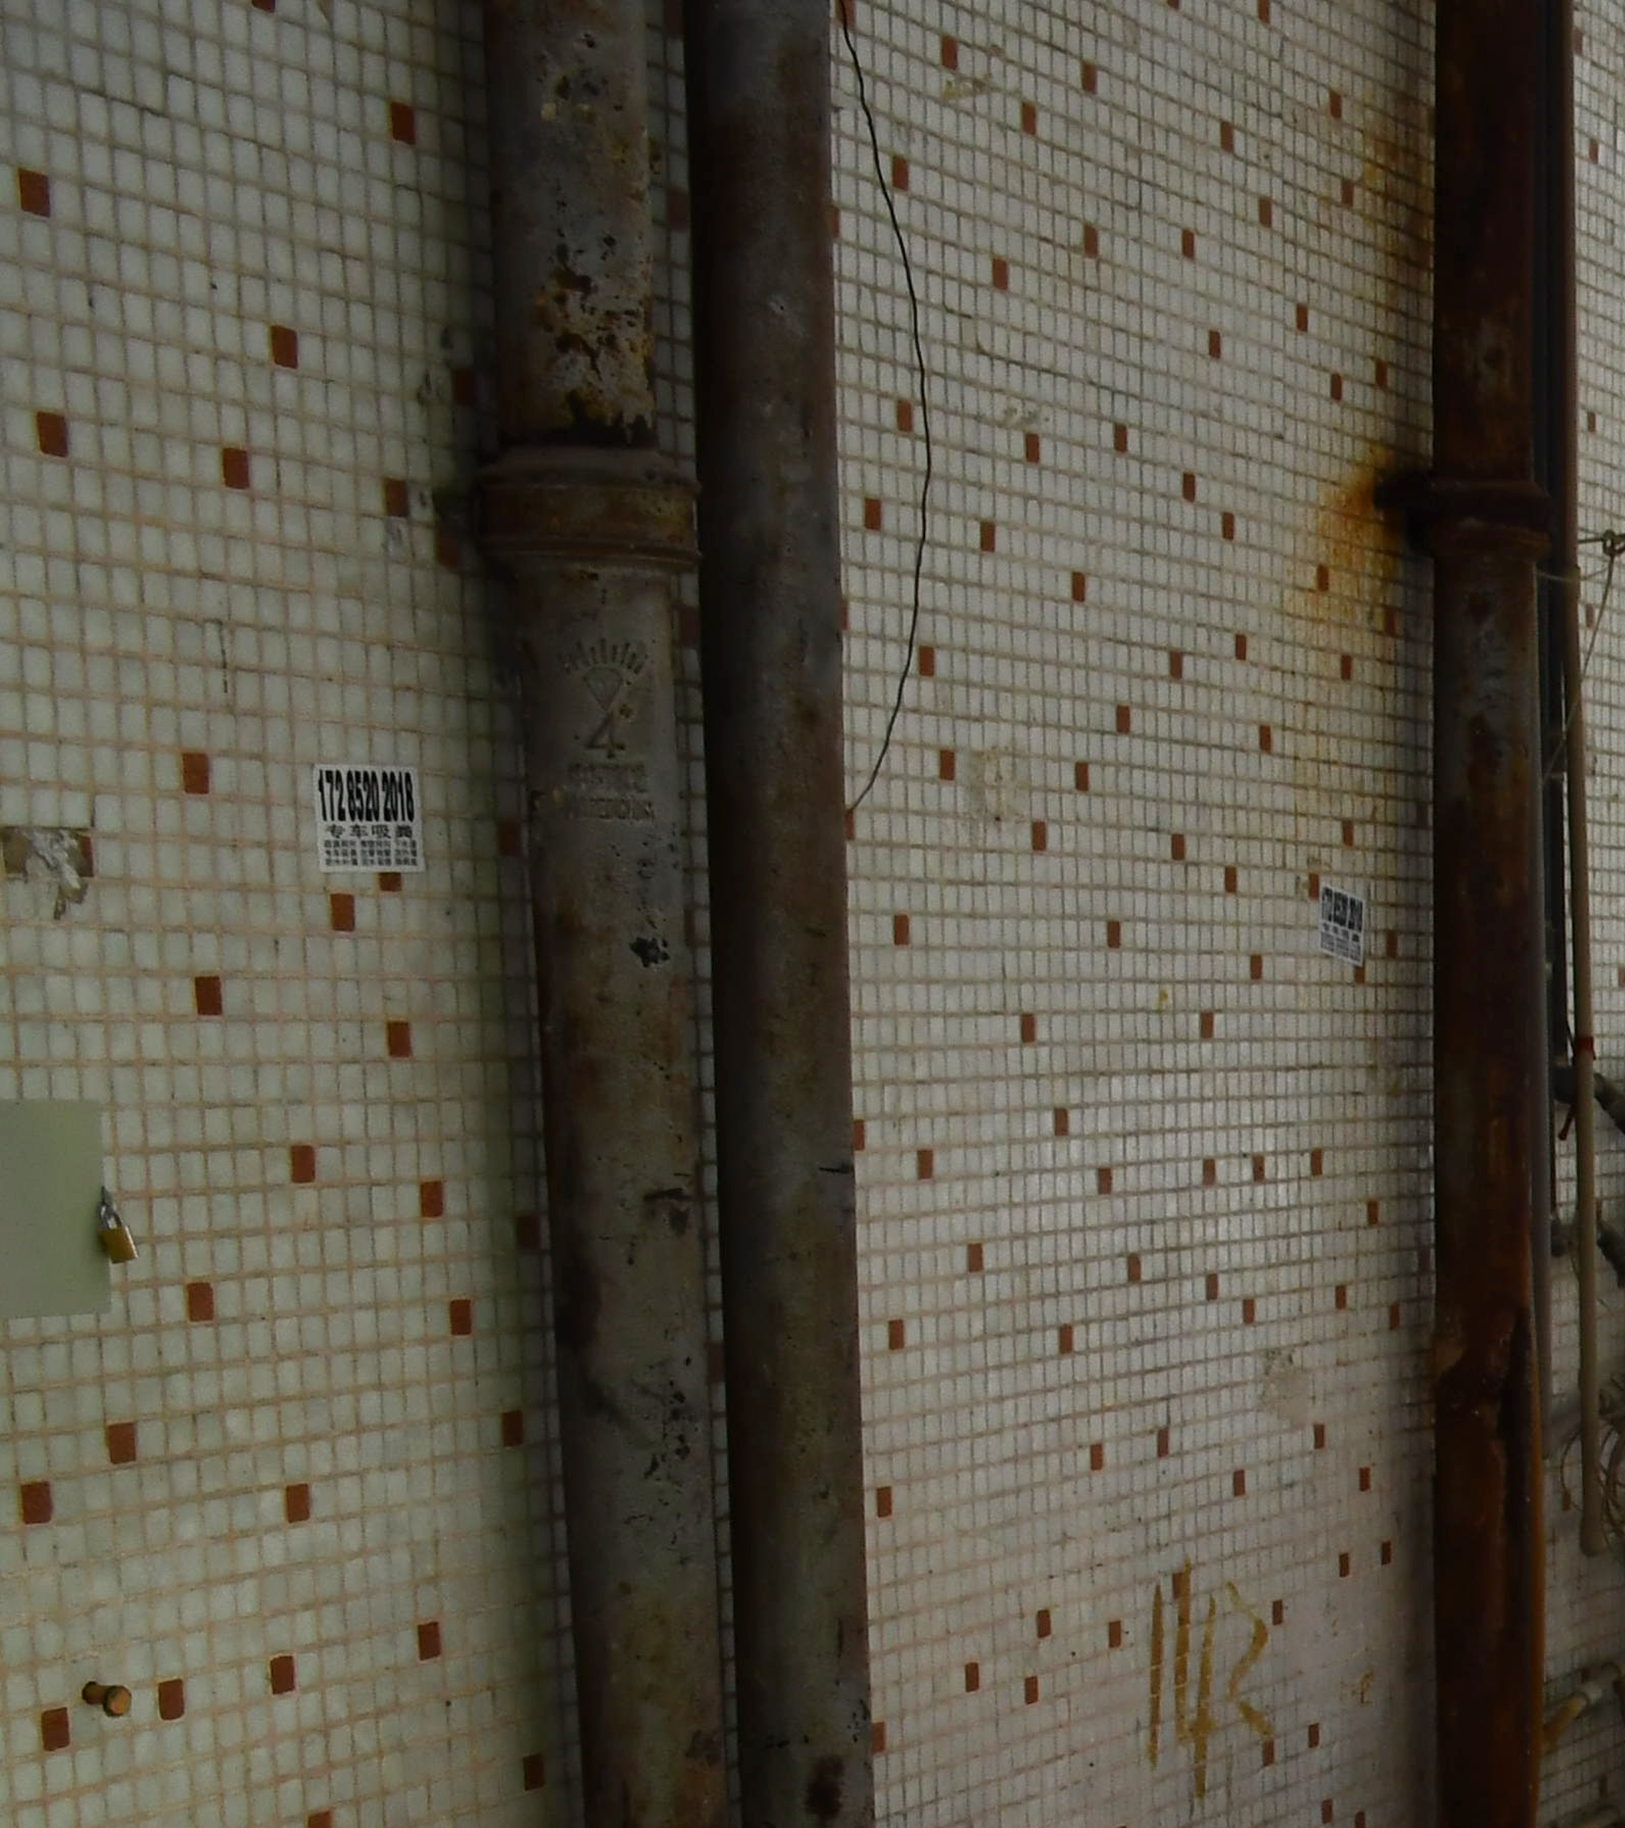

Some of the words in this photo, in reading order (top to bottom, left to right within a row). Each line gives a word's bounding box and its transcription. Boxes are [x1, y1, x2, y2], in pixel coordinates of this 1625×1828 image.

[318, 769, 346, 822] 172
[346, 769, 379, 822] 8520
[382, 770, 415, 822] 2018
